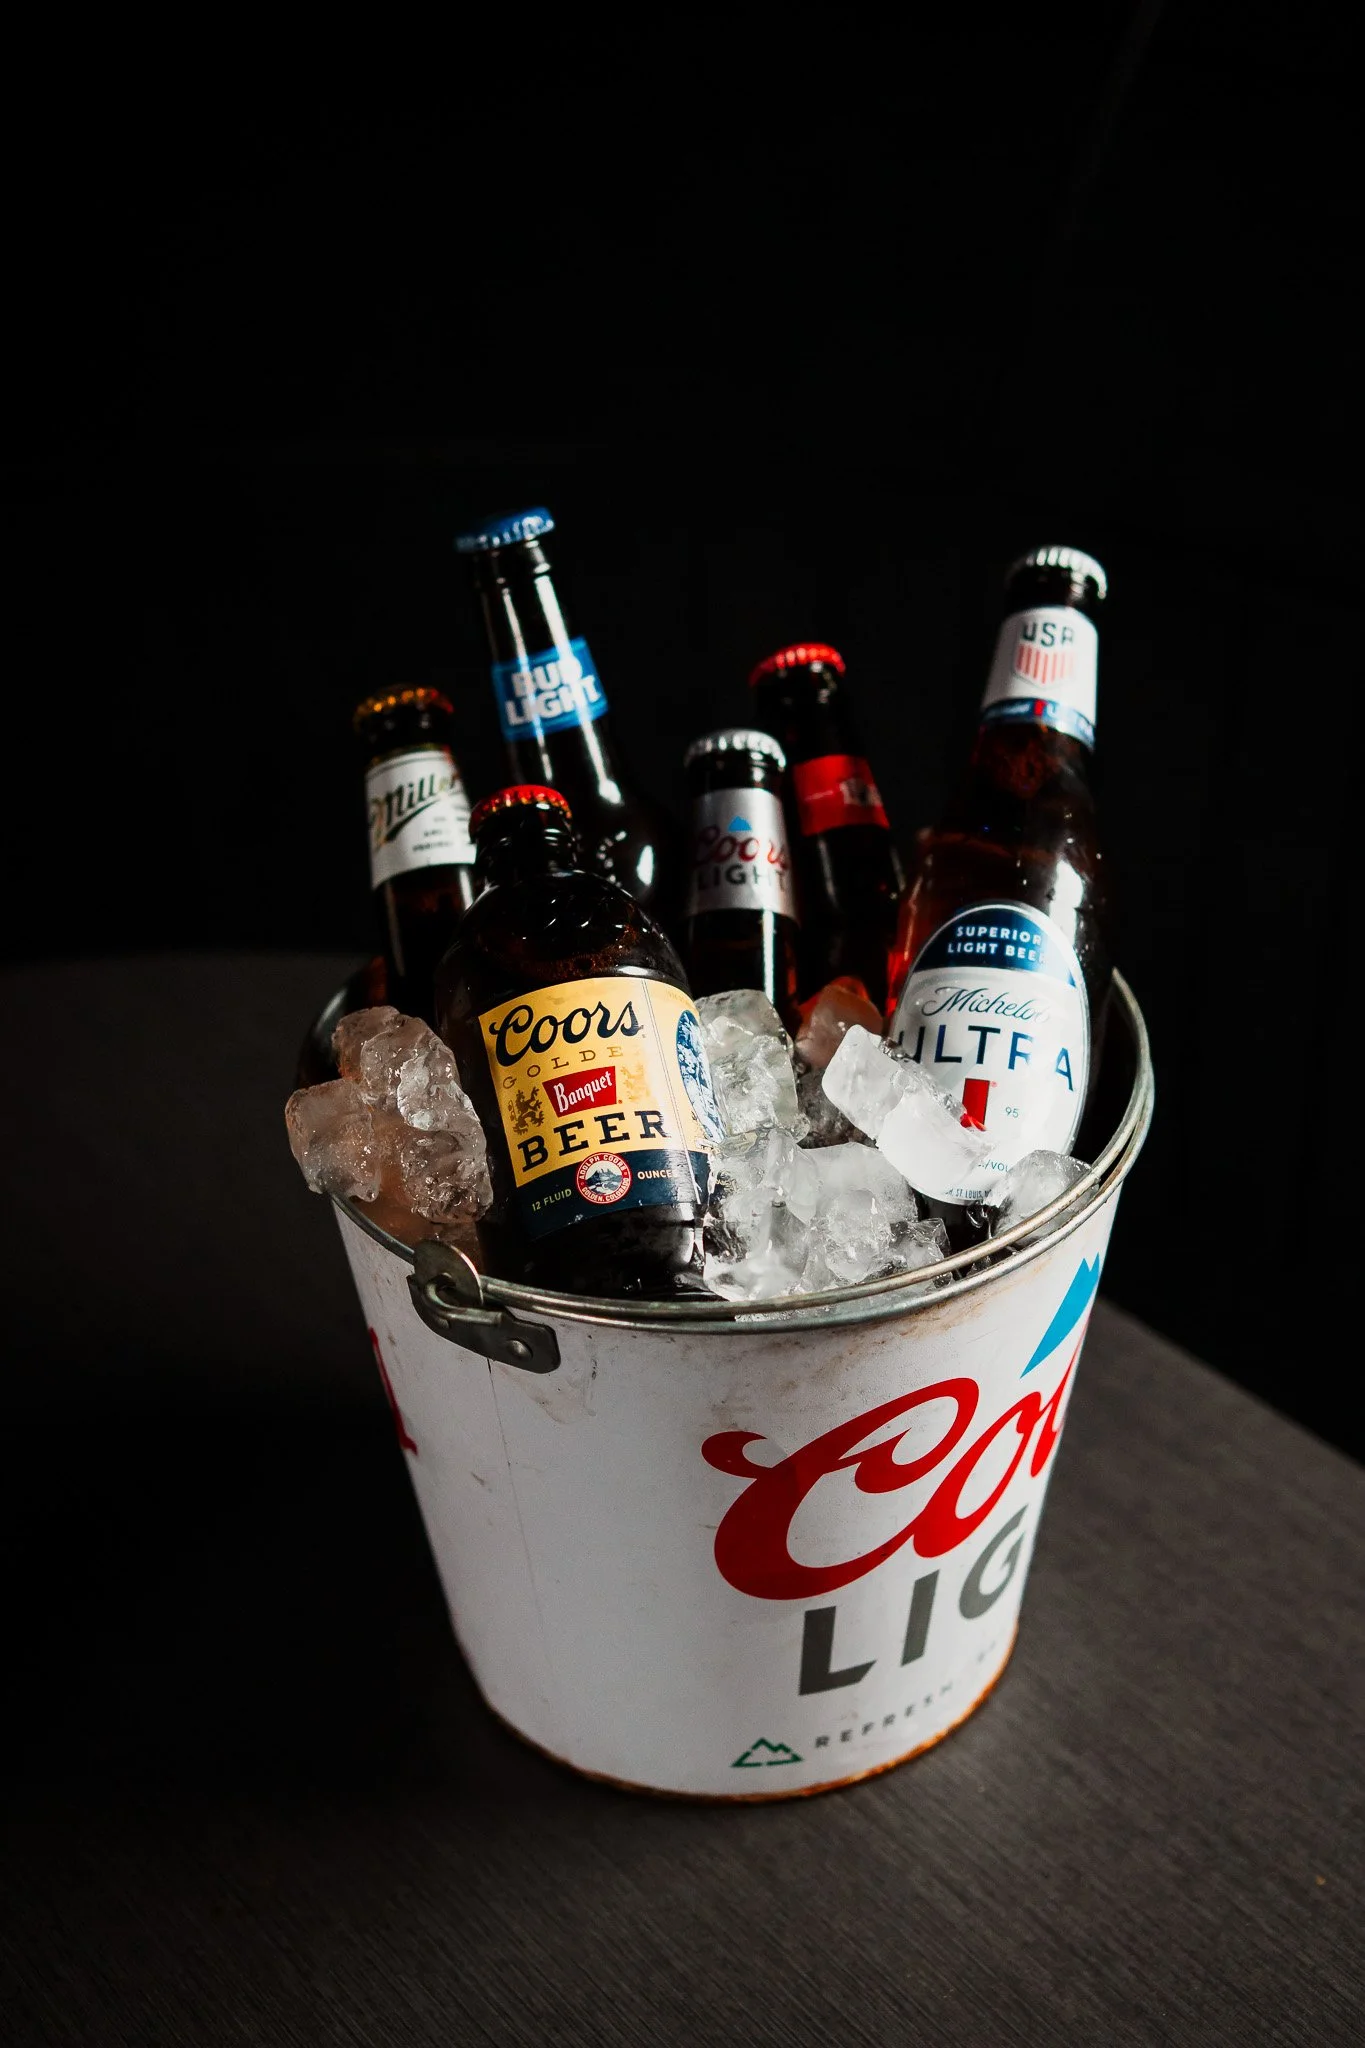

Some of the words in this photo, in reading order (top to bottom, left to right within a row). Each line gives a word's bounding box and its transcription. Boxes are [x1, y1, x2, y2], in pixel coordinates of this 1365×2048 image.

[1021, 621, 1075, 648] USA
[947, 942, 998, 954] LIGHT
[956, 925, 1042, 946] SUPERIOR
[489, 1000, 643, 1067] Coors
[502, 1046, 641, 1090] GOLDE
[553, 1070, 613, 1113] Banquet
[1005, 1106, 1020, 1119] 95
[517, 1110, 672, 1172] BEER
[579, 1155, 600, 1180] ADOLPH
[603, 1155, 627, 1173] COORS
[532, 1200, 541, 1212] 12
[543, 1188, 572, 1206] FLUID
[605, 1177, 629, 1201] COLORADO
[799, 1503, 1029, 1696] LIG
